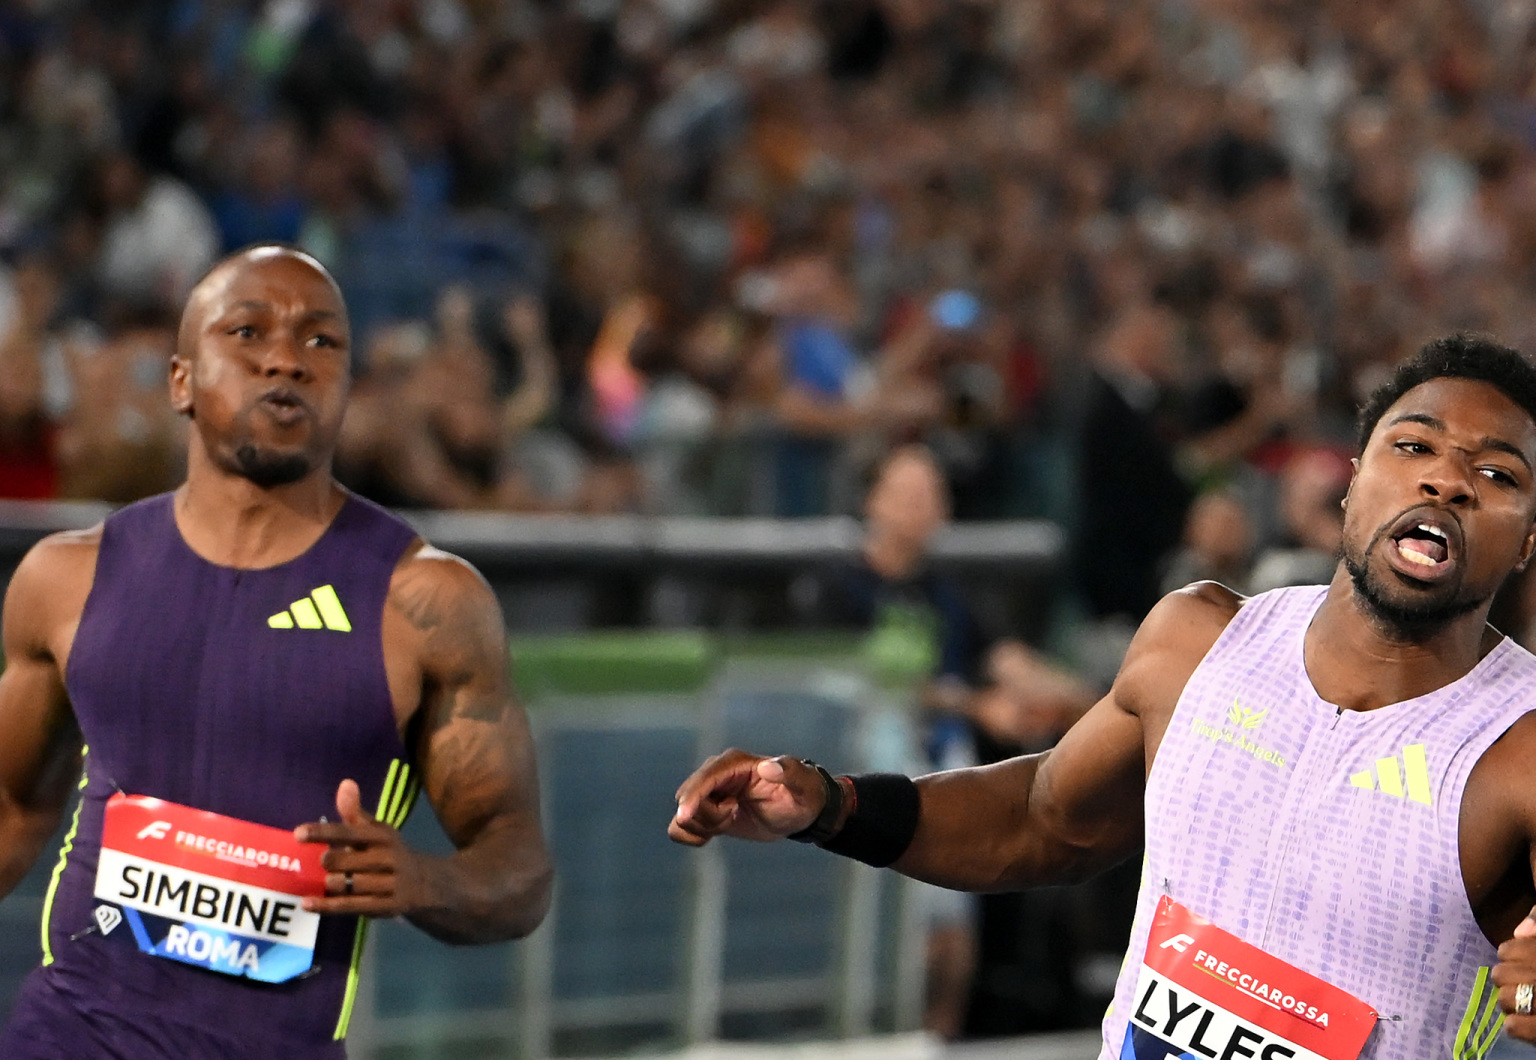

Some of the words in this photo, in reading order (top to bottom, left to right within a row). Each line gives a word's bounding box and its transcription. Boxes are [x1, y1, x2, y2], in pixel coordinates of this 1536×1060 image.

[1235, 734, 1285, 767] Angels
[175, 831, 301, 872] FRECCIAROSSA
[119, 865, 296, 936] SIMBINE
[165, 924, 259, 972] ROMA
[1194, 949, 1329, 1027] FRECCIAROSSA
